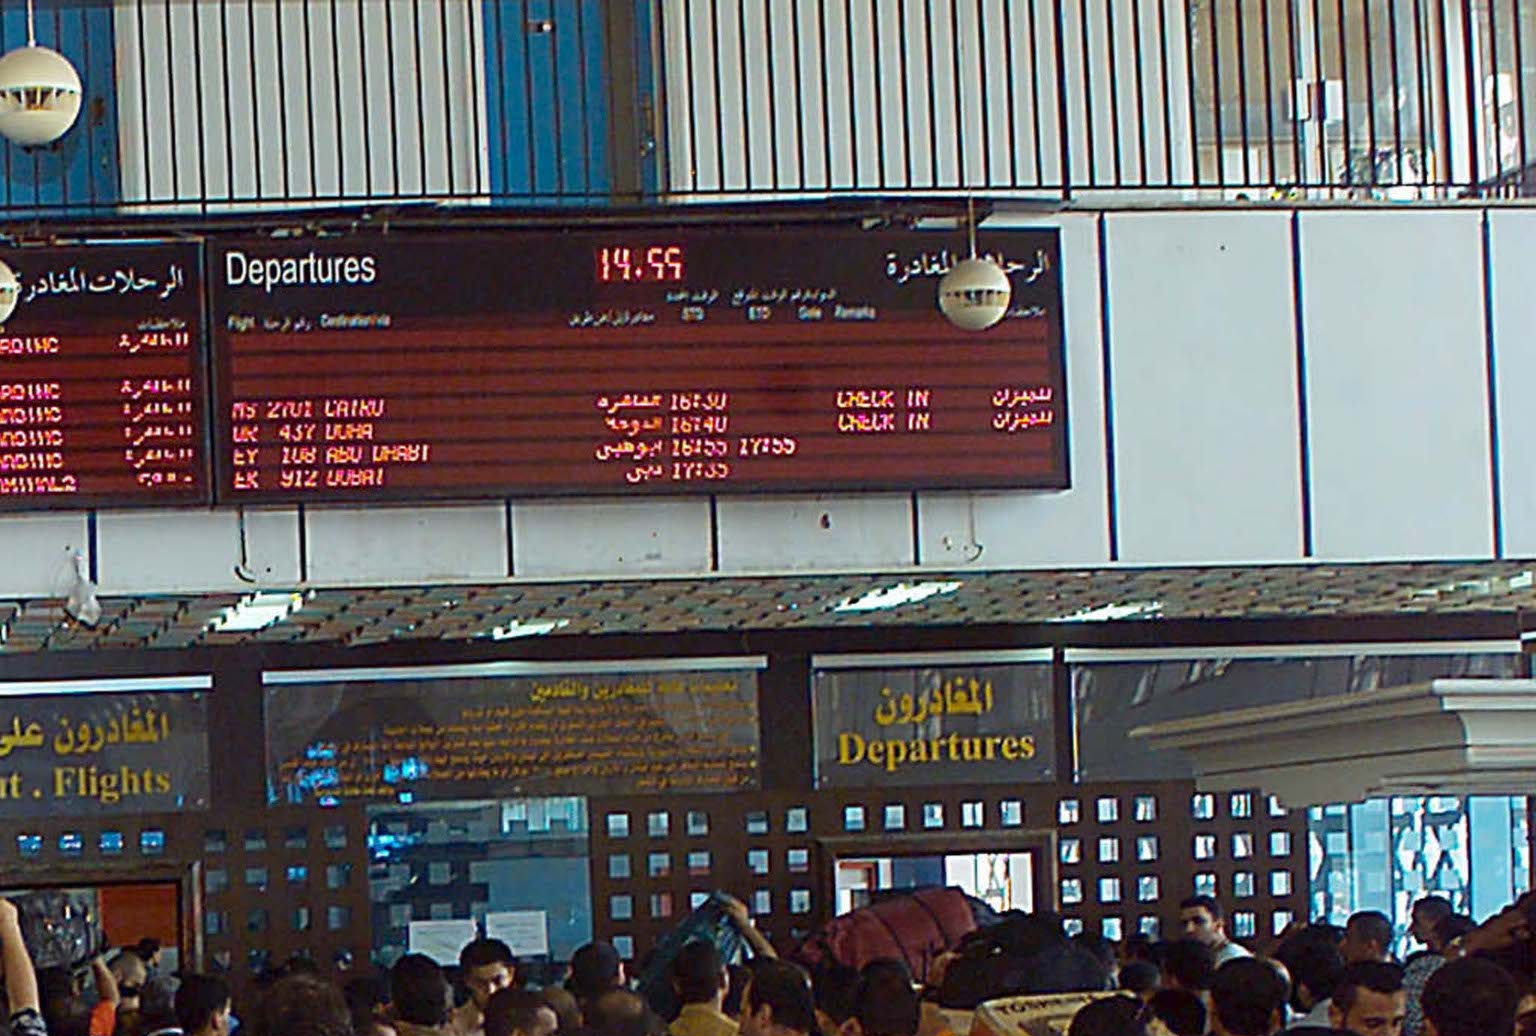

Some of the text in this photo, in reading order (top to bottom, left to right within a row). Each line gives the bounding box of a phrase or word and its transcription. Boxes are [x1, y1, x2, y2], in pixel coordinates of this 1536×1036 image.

[226, 252, 376, 292] Departures
[873, 676, 994, 727] المغادرون
[54, 707, 170, 757] المغادرون
[838, 732, 1036, 772] Departures
[54, 764, 171, 807] Flights
